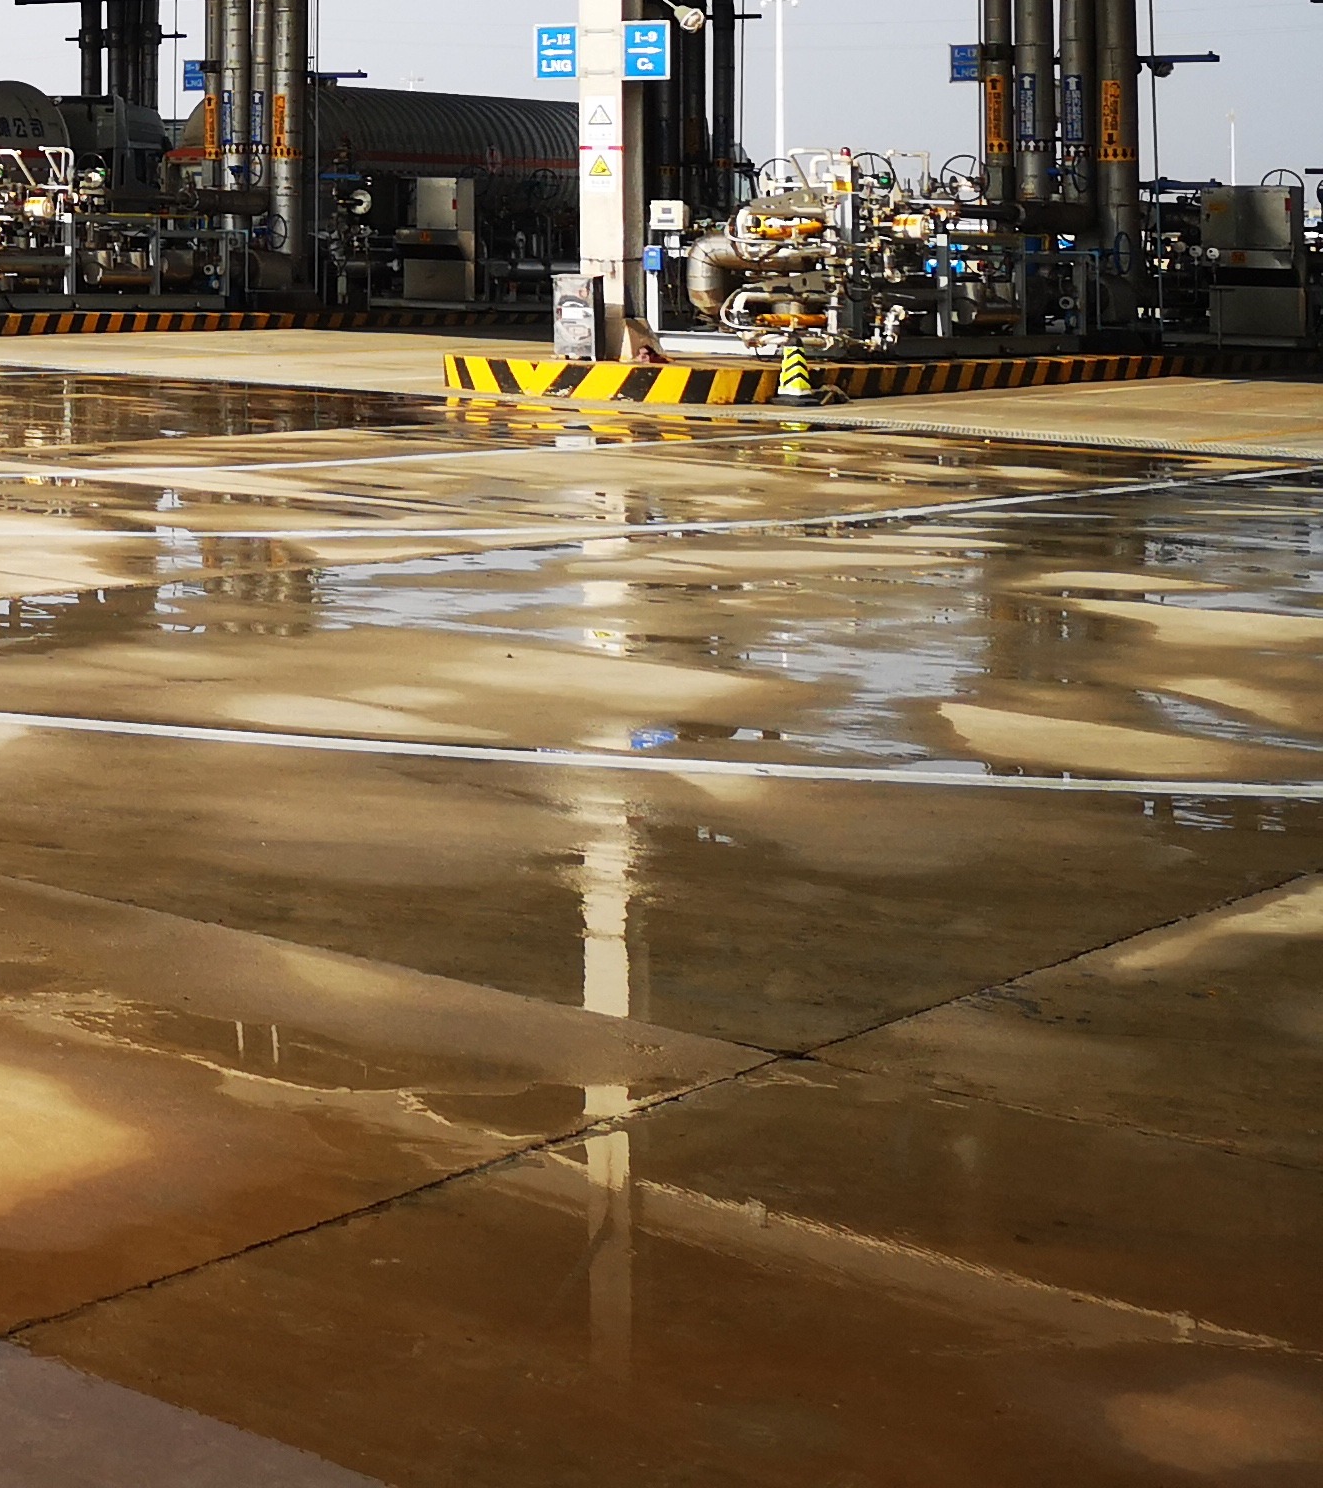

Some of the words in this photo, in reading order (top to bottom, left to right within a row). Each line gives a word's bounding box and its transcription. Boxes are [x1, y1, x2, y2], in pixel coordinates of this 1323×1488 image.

[541, 33, 571, 45] L-12
[541, 59, 572, 72] LNG
[953, 68, 978, 78] LNG
